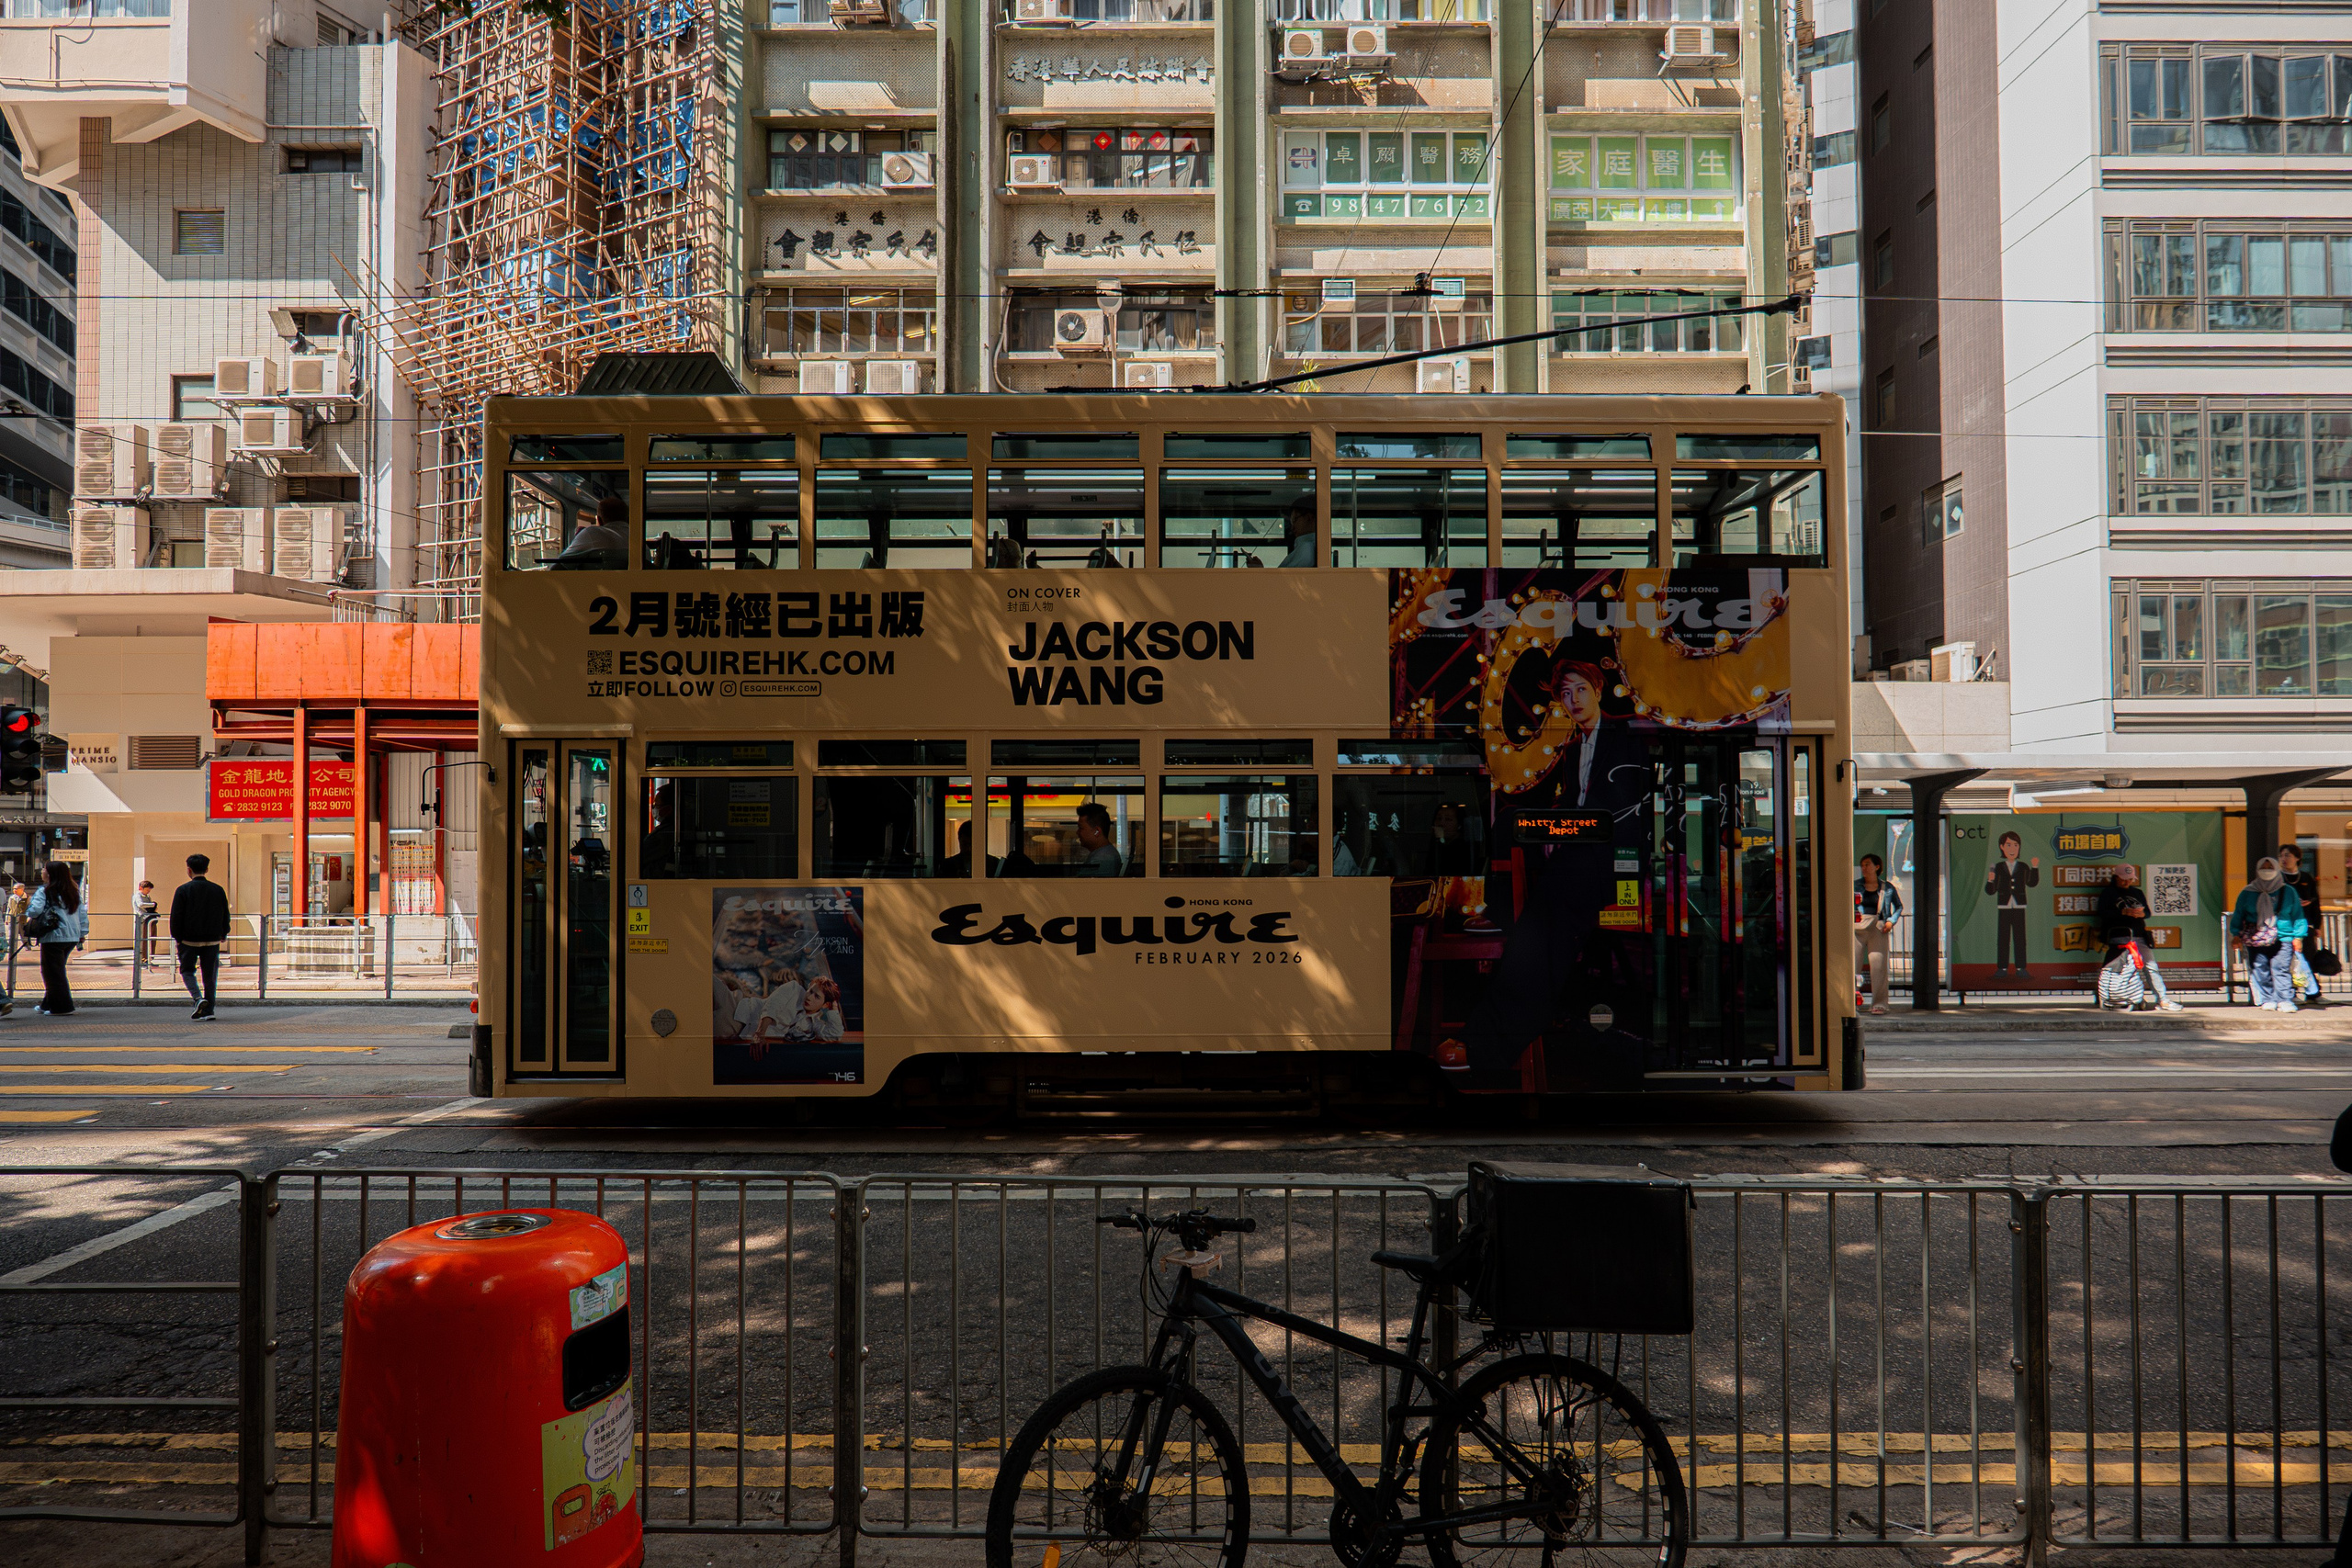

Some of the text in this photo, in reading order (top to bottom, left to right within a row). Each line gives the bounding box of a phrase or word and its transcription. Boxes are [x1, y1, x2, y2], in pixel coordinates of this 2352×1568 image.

[1007, 55, 1215, 82] 香港華人足球聯會
[1556, 149, 1726, 176] 家庭醫生
[1007, 587, 1081, 599] ON COVER
[588, 591, 926, 638] 2月號經已出版
[1007, 601, 1054, 613] 封面人物
[1417, 583, 1762, 638] Esquire
[1008, 620, 1254, 661] JACKSON
[619, 650, 895, 677] ESQUIREHK.COM
[743, 684, 818, 693] ESQUIREHK.COM
[1007, 665, 1164, 706] WANG
[219, 768, 356, 784] 金龍地公司
[219, 787, 356, 798] GOLD DRAGON PROTY AGENCY
[236, 802, 258, 812] 2832
[261, 802, 283, 811] 9123
[330, 801, 352, 810] 9070
[1518, 818, 1598, 828] Whitty Street
[1549, 827, 1579, 835] Depot
[1954, 824, 1986, 840] bct
[2059, 834, 2121, 850] 市場首創
[722, 893, 854, 916] Esquire
[931, 896, 1299, 956] Esquire
[1136, 951, 1303, 964] FEBRUARY 2026
[834, 1071, 856, 1082] 146
[594, 1455, 604, 1464] the
[594, 1451, 620, 1475] prosecuted
